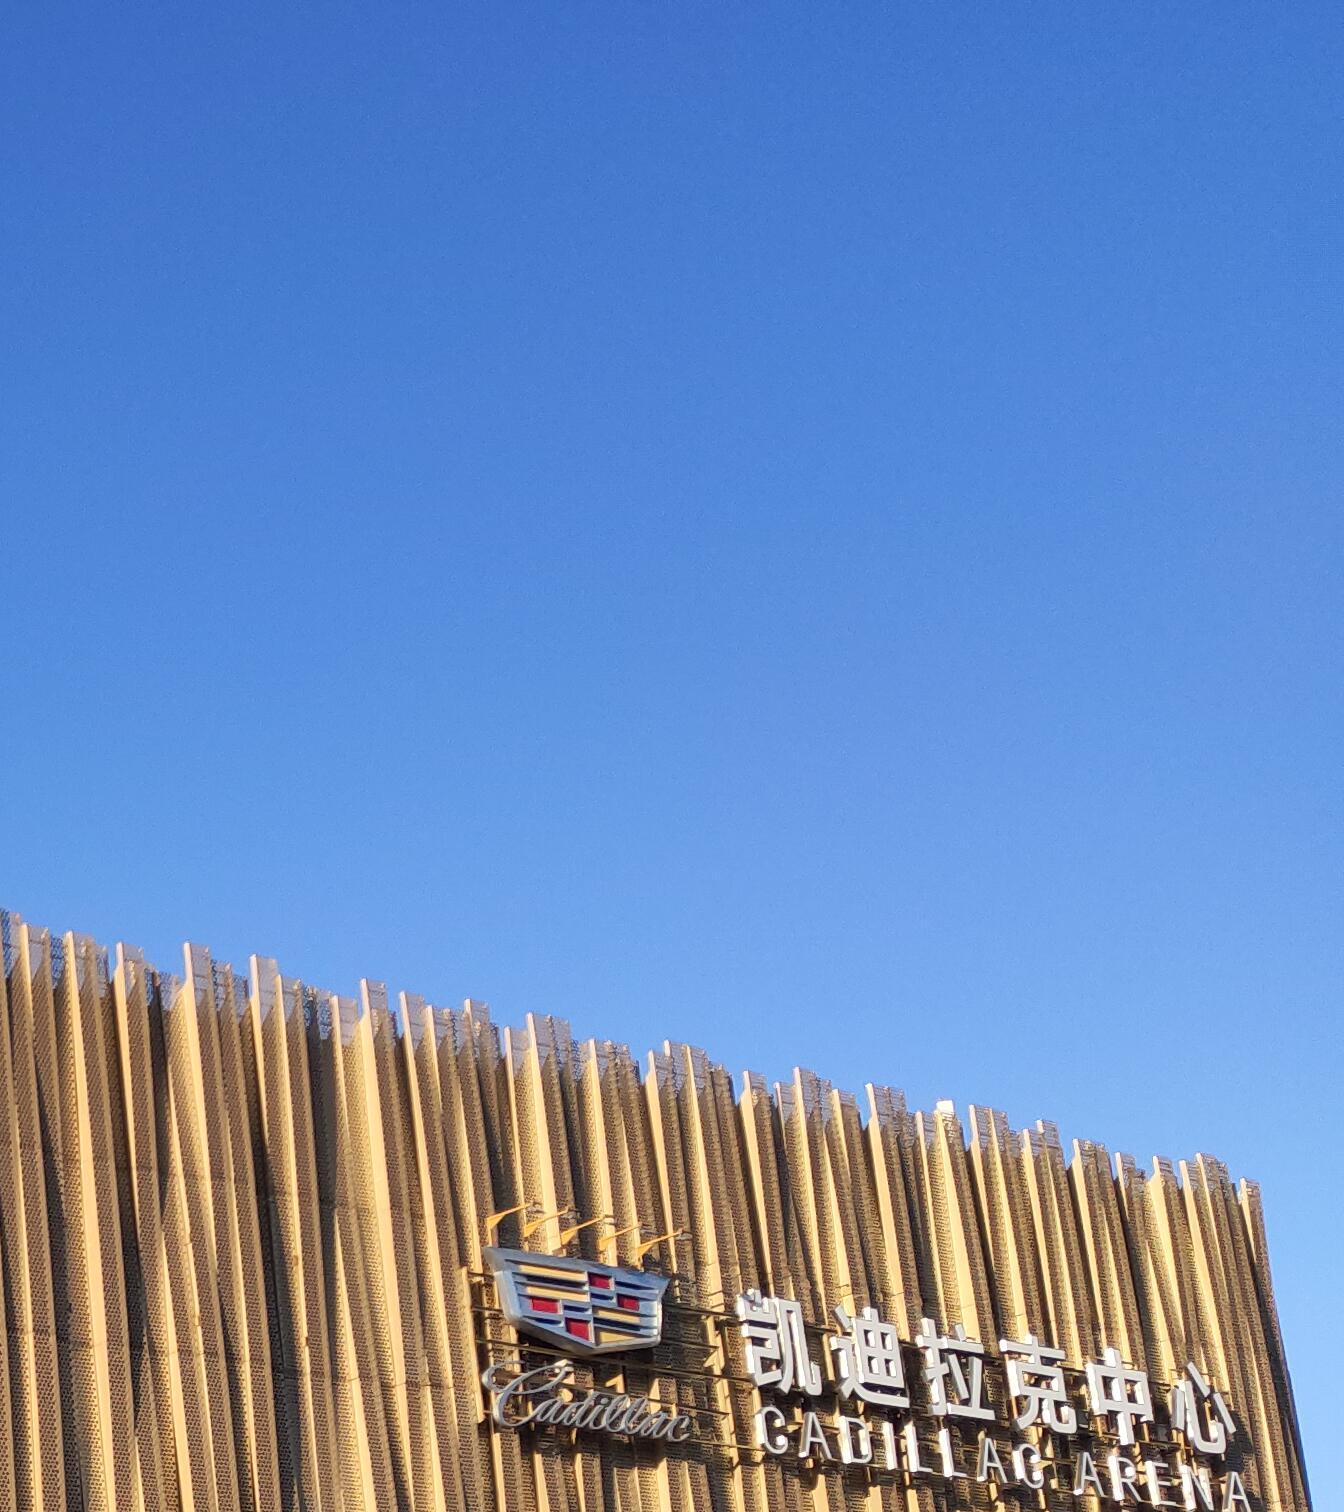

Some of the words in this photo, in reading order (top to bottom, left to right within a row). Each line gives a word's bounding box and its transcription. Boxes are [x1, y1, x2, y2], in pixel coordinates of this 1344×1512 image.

[482, 1359, 690, 1442] Cadillac
[737, 1288, 1236, 1454] 凯迪拉克中心
[755, 1406, 1044, 1489] CADILLAC
